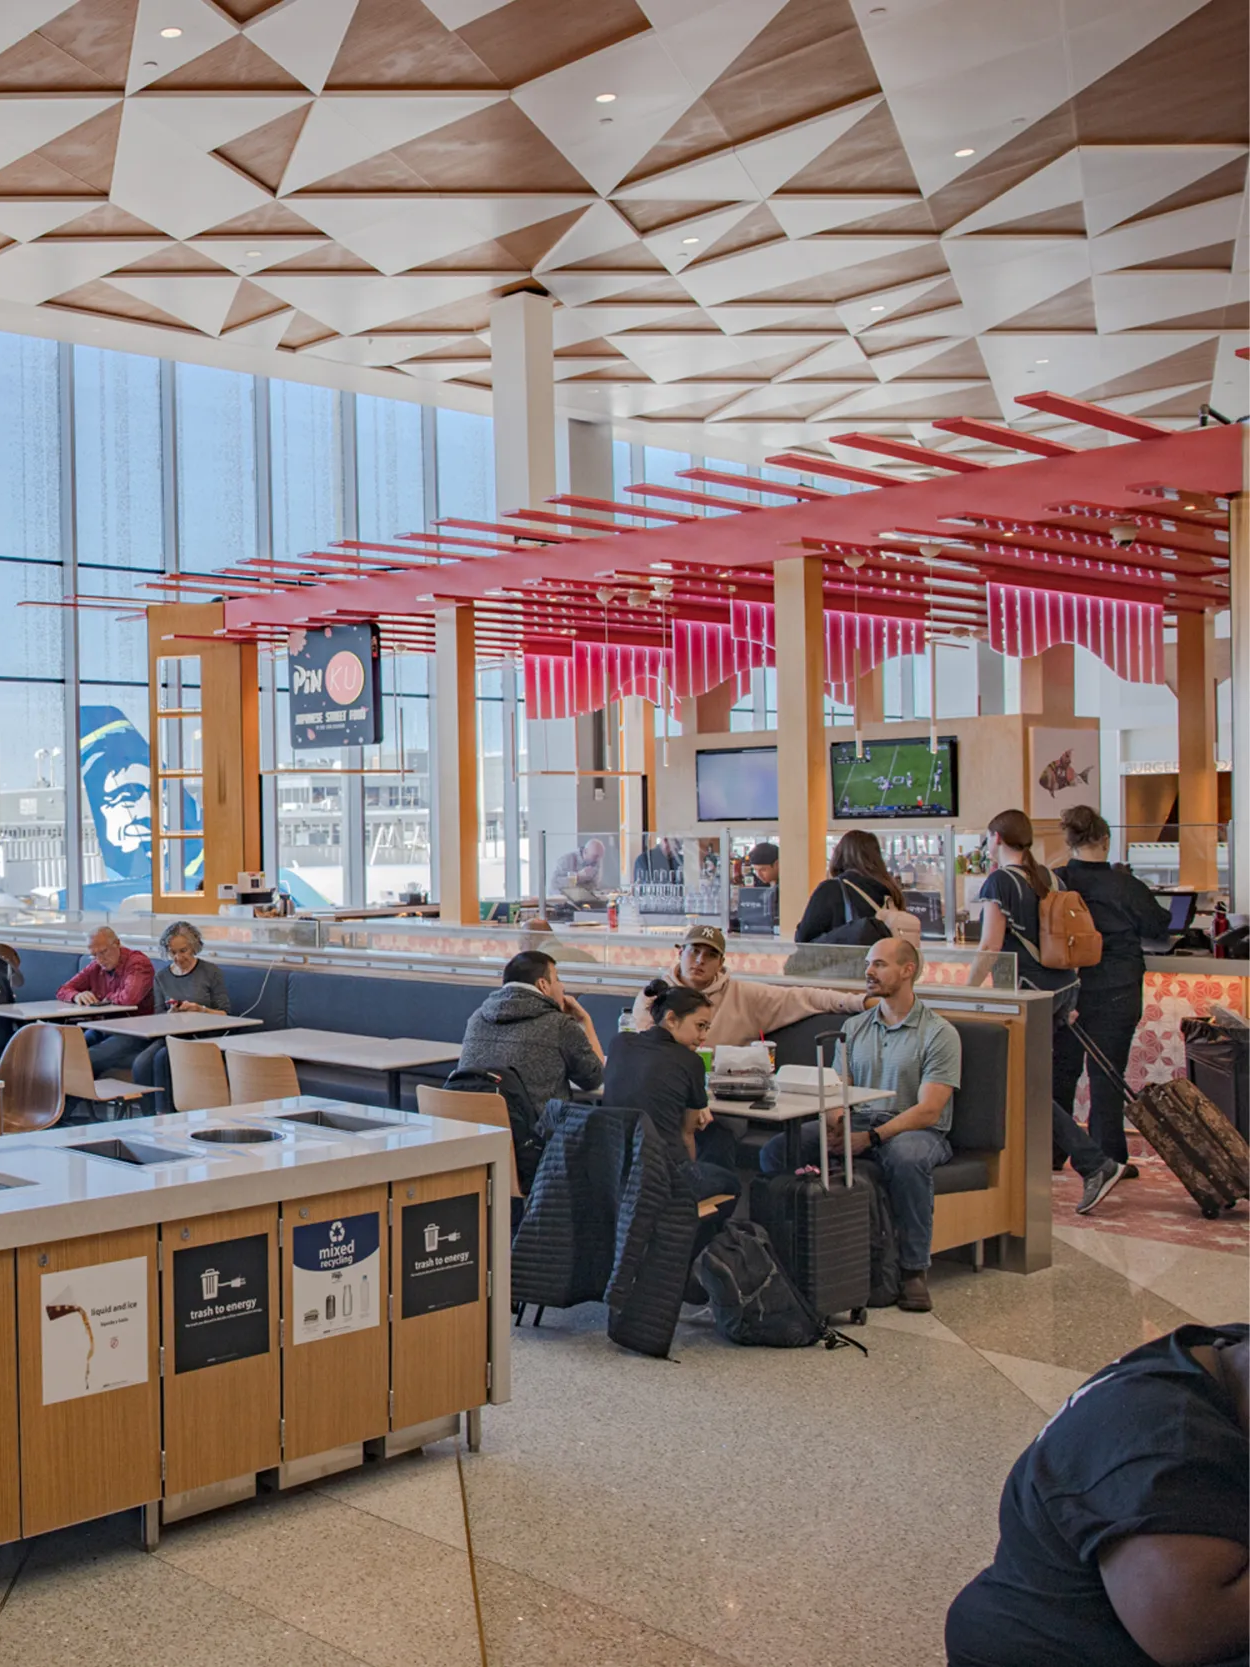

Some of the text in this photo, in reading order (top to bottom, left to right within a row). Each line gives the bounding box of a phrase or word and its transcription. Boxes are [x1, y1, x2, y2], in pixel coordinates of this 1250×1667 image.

[330, 665, 357, 691] KU
[701, 927, 714, 938] NY
[319, 1239, 355, 1260] mixed
[320, 1255, 353, 1268] recycling
[415, 1257, 434, 1270] trash
[435, 1257, 443, 1266] to
[444, 1251, 470, 1263] energy
[91, 1300, 137, 1316] liquid and ice
[190, 1305, 213, 1320] trash
[215, 1304, 225, 1314] to
[226, 1298, 257, 1310] energy
